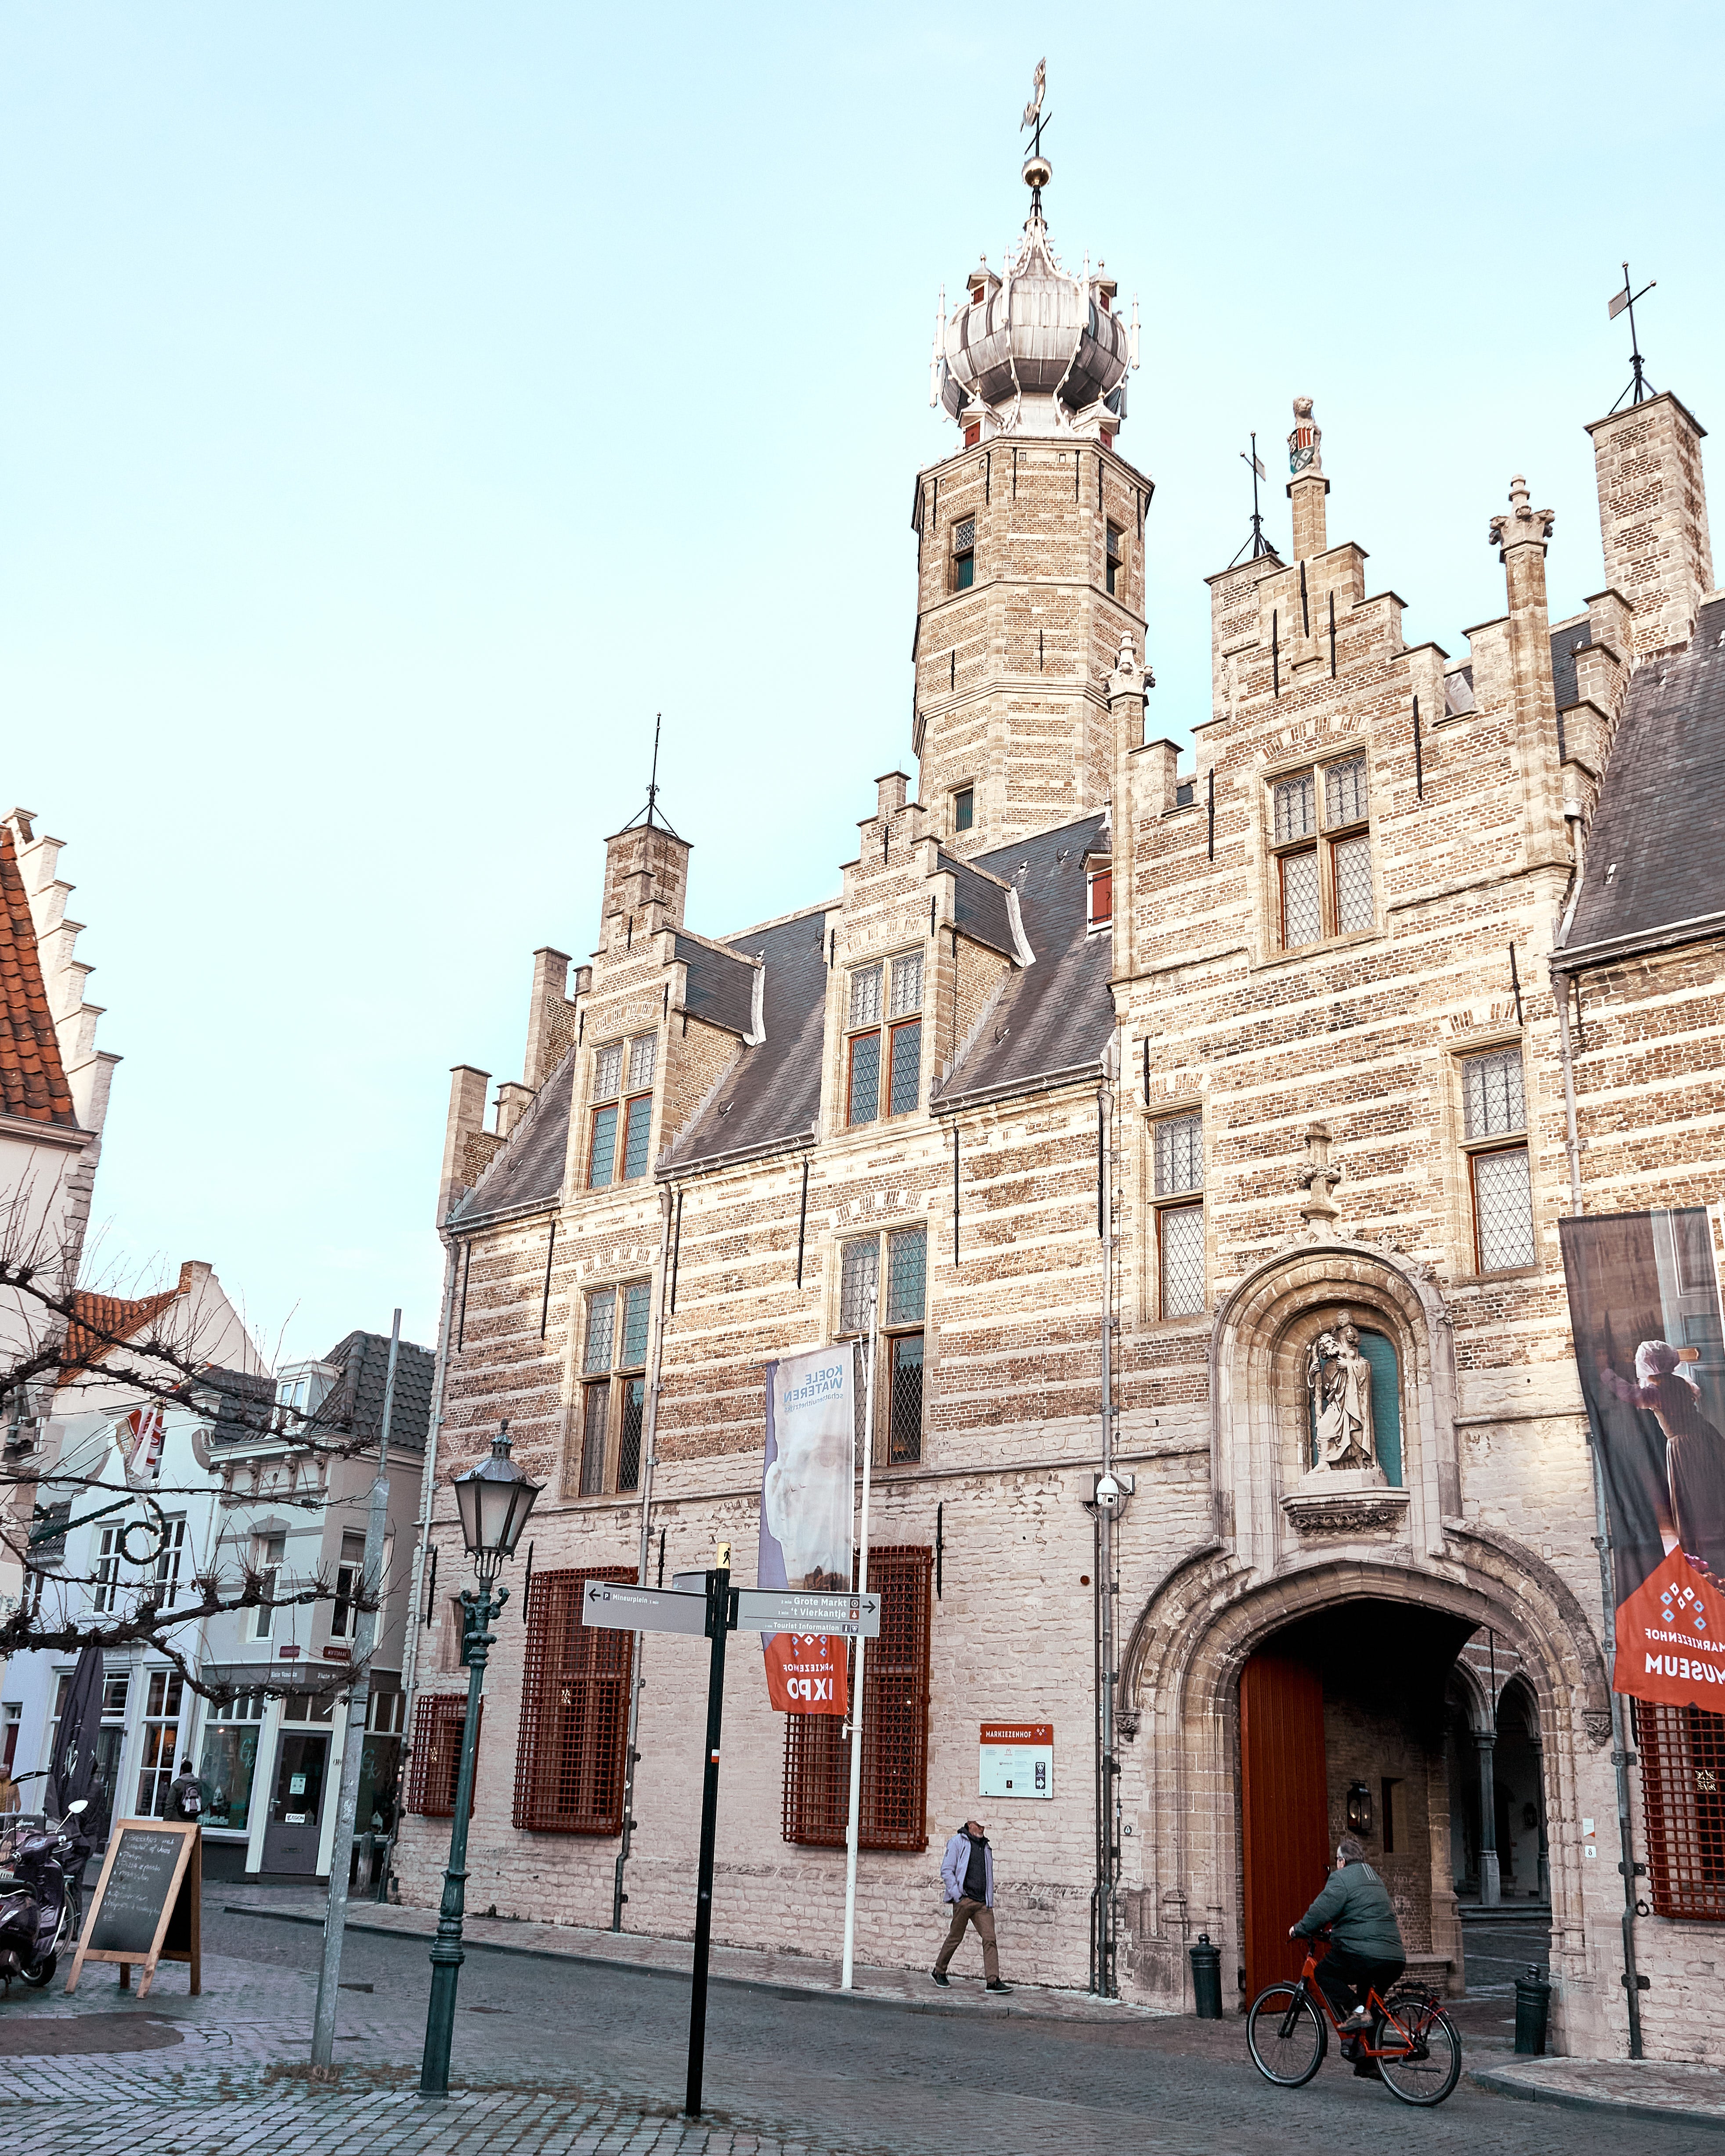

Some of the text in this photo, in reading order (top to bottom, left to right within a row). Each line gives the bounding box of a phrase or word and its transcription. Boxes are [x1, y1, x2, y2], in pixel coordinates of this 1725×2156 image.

[613, 1594, 648, 1603] Mineurplein
[794, 1597, 819, 1605] Grote
[821, 1598, 847, 1607] Markt
[800, 1608, 846, 1619] Vierkantje
